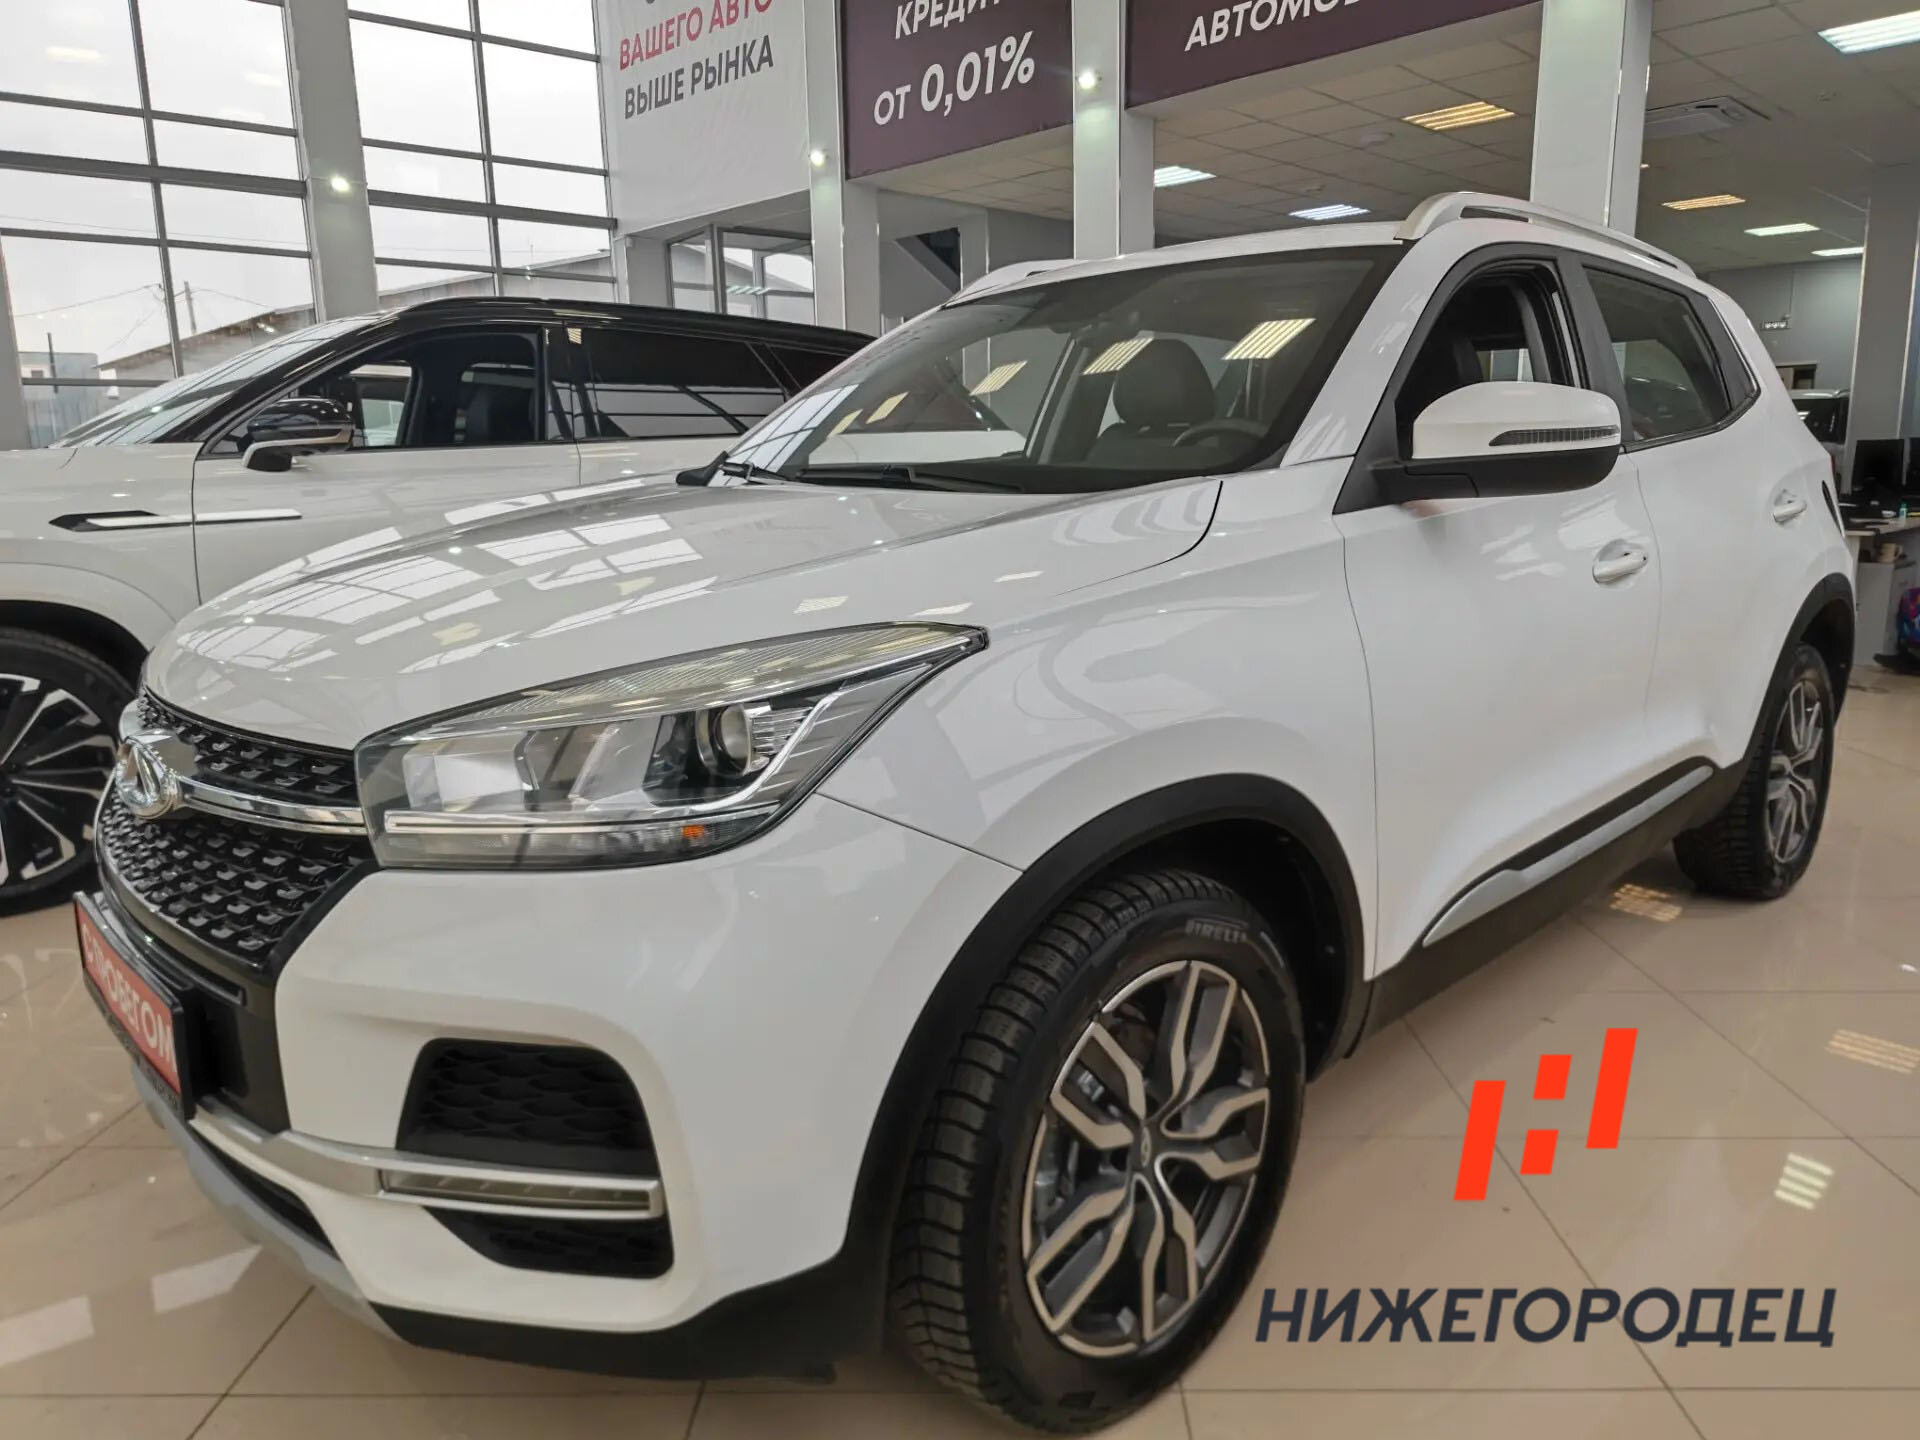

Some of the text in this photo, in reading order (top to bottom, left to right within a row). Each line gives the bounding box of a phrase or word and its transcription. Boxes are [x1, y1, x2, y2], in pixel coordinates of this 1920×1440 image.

[620, 7, 703, 71] ВАШЕГО
[895, 0, 1000, 39] КРЕД
[1184, 0, 1359, 51] АВТОМ
[624, 35, 774, 120] ВЫШЕ РЫНКА
[921, 30, 1035, 117] 0,01%
